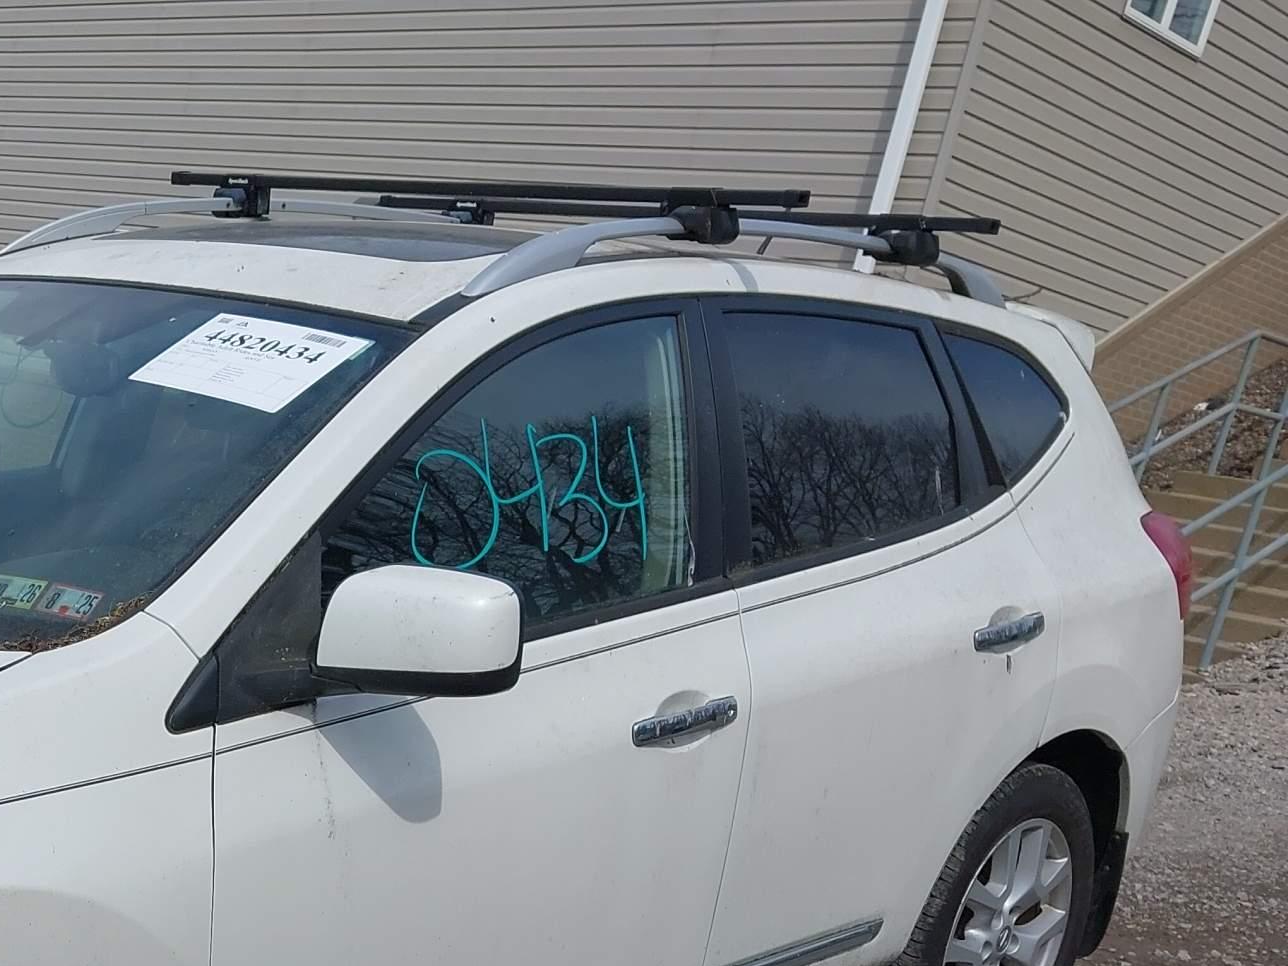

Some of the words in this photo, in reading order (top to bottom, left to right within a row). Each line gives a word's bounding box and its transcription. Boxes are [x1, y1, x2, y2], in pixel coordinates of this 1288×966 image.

[204, 329, 327, 364] 44820434
[411, 416, 649, 570] 0434
[20, 584, 43, 603] 26
[76, 594, 99, 615] 25
